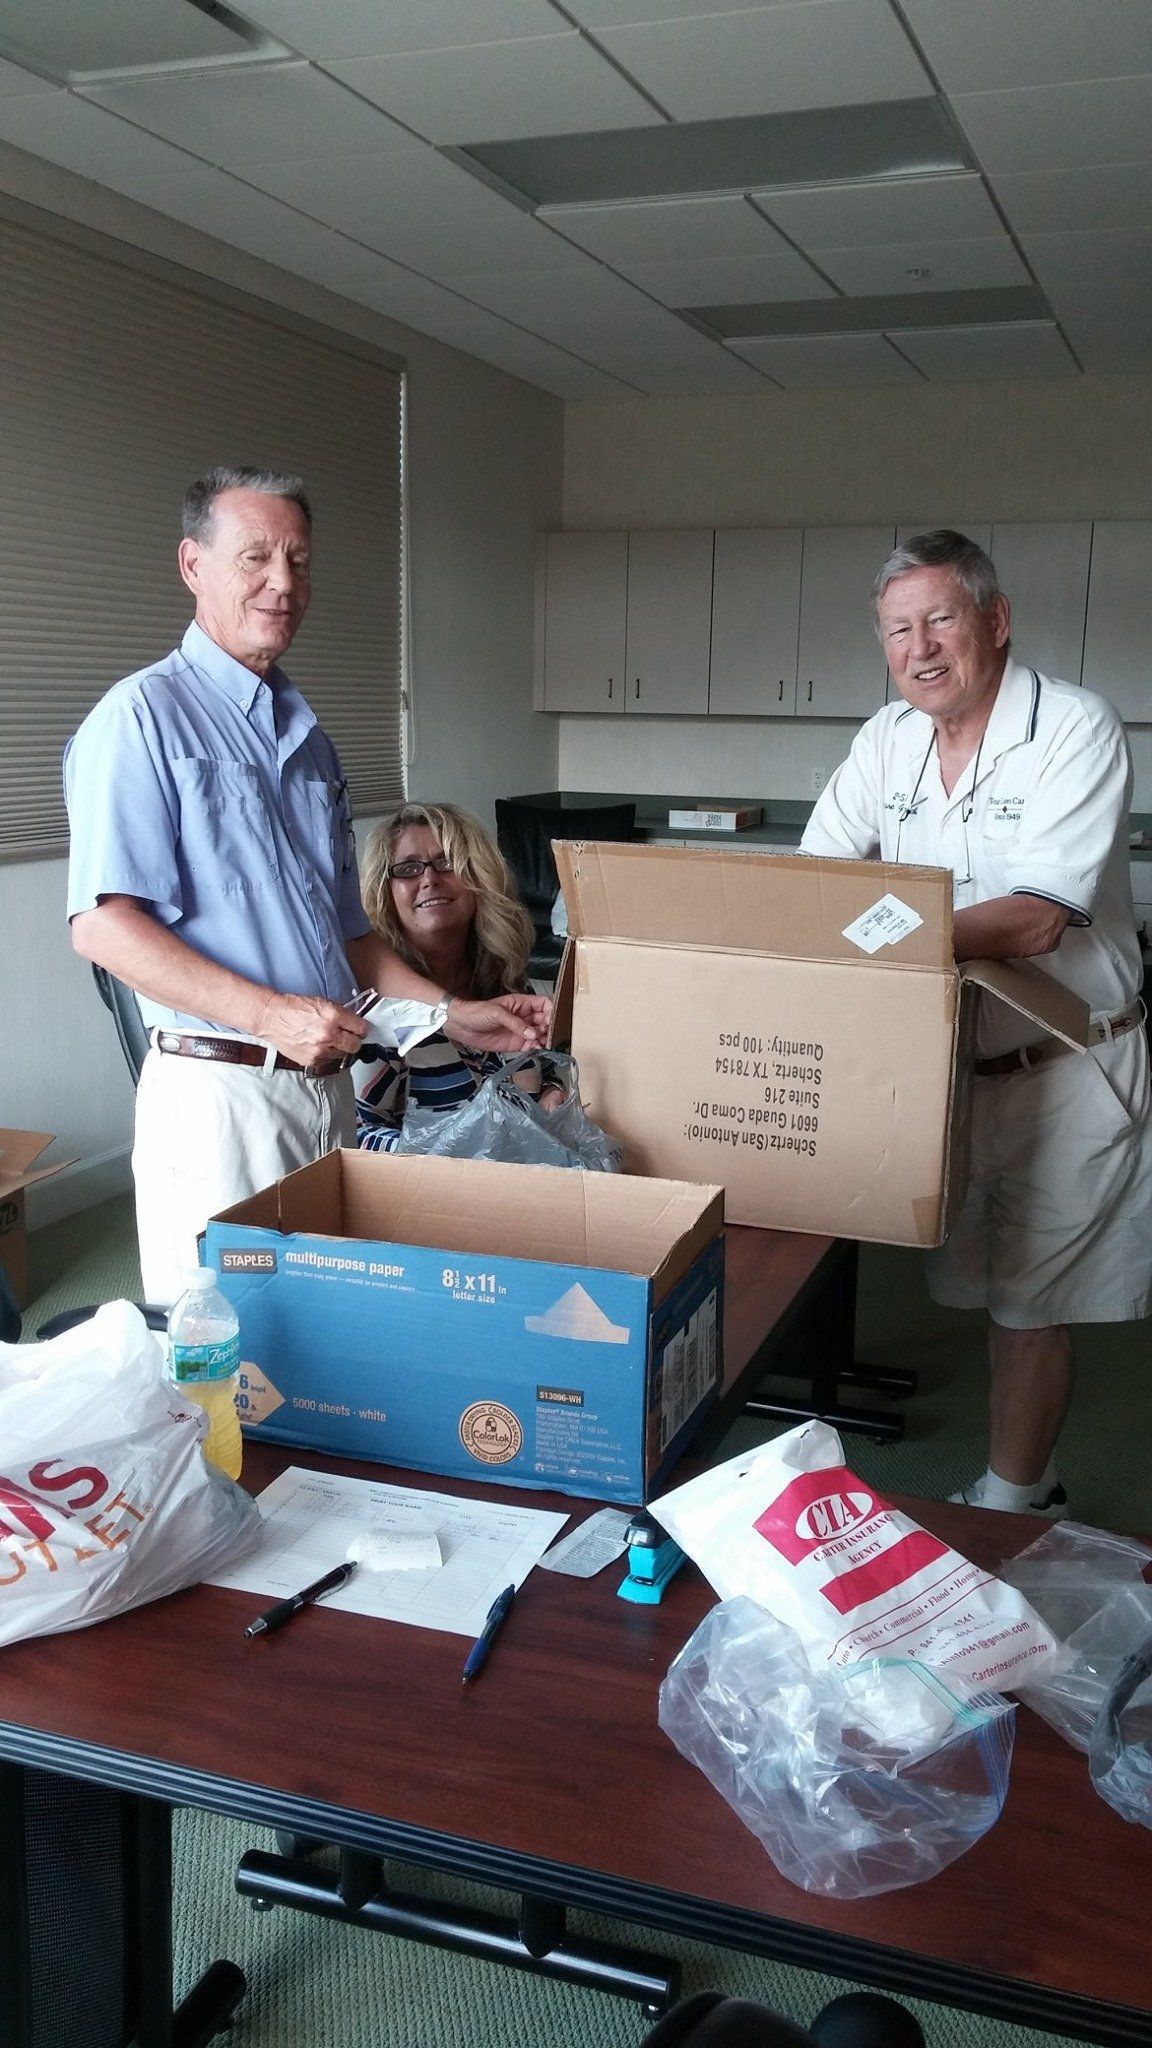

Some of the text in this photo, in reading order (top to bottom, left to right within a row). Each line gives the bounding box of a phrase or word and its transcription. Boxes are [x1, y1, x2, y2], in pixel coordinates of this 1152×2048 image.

[719, 1032, 824, 1061] Quantity: 100 pcs
[715, 1057, 822, 1085] Schertz, TX 78154
[764, 1086, 820, 1109] Suite 216
[692, 1101, 818, 1133] 6601 Guada Coma Dr.
[683, 1124, 740, 1147] Antonio):
[223, 1254, 274, 1267] STAPLES
[285, 1251, 405, 1277] multipurpose paper
[452, 1289, 496, 1304] letter size
[239, 1374, 249, 1390] 6
[292, 1397, 387, 1422] 5000 sheets white
[539, 1391, 582, 1404] 513096-WH
[581, 1411, 599, 1421] Group
[473, 1430, 510, 1443] ColorLok
[806, 1492, 864, 1538] CIA
[813, 1513, 893, 1562] CARTER INSURANC
[848, 1540, 883, 1566] AGENCY
[853, 1630, 880, 1645] Church
[883, 1606, 925, 1632] Commercial
[927, 1587, 951, 1607] Flood
[953, 1569, 976, 1589] Home
